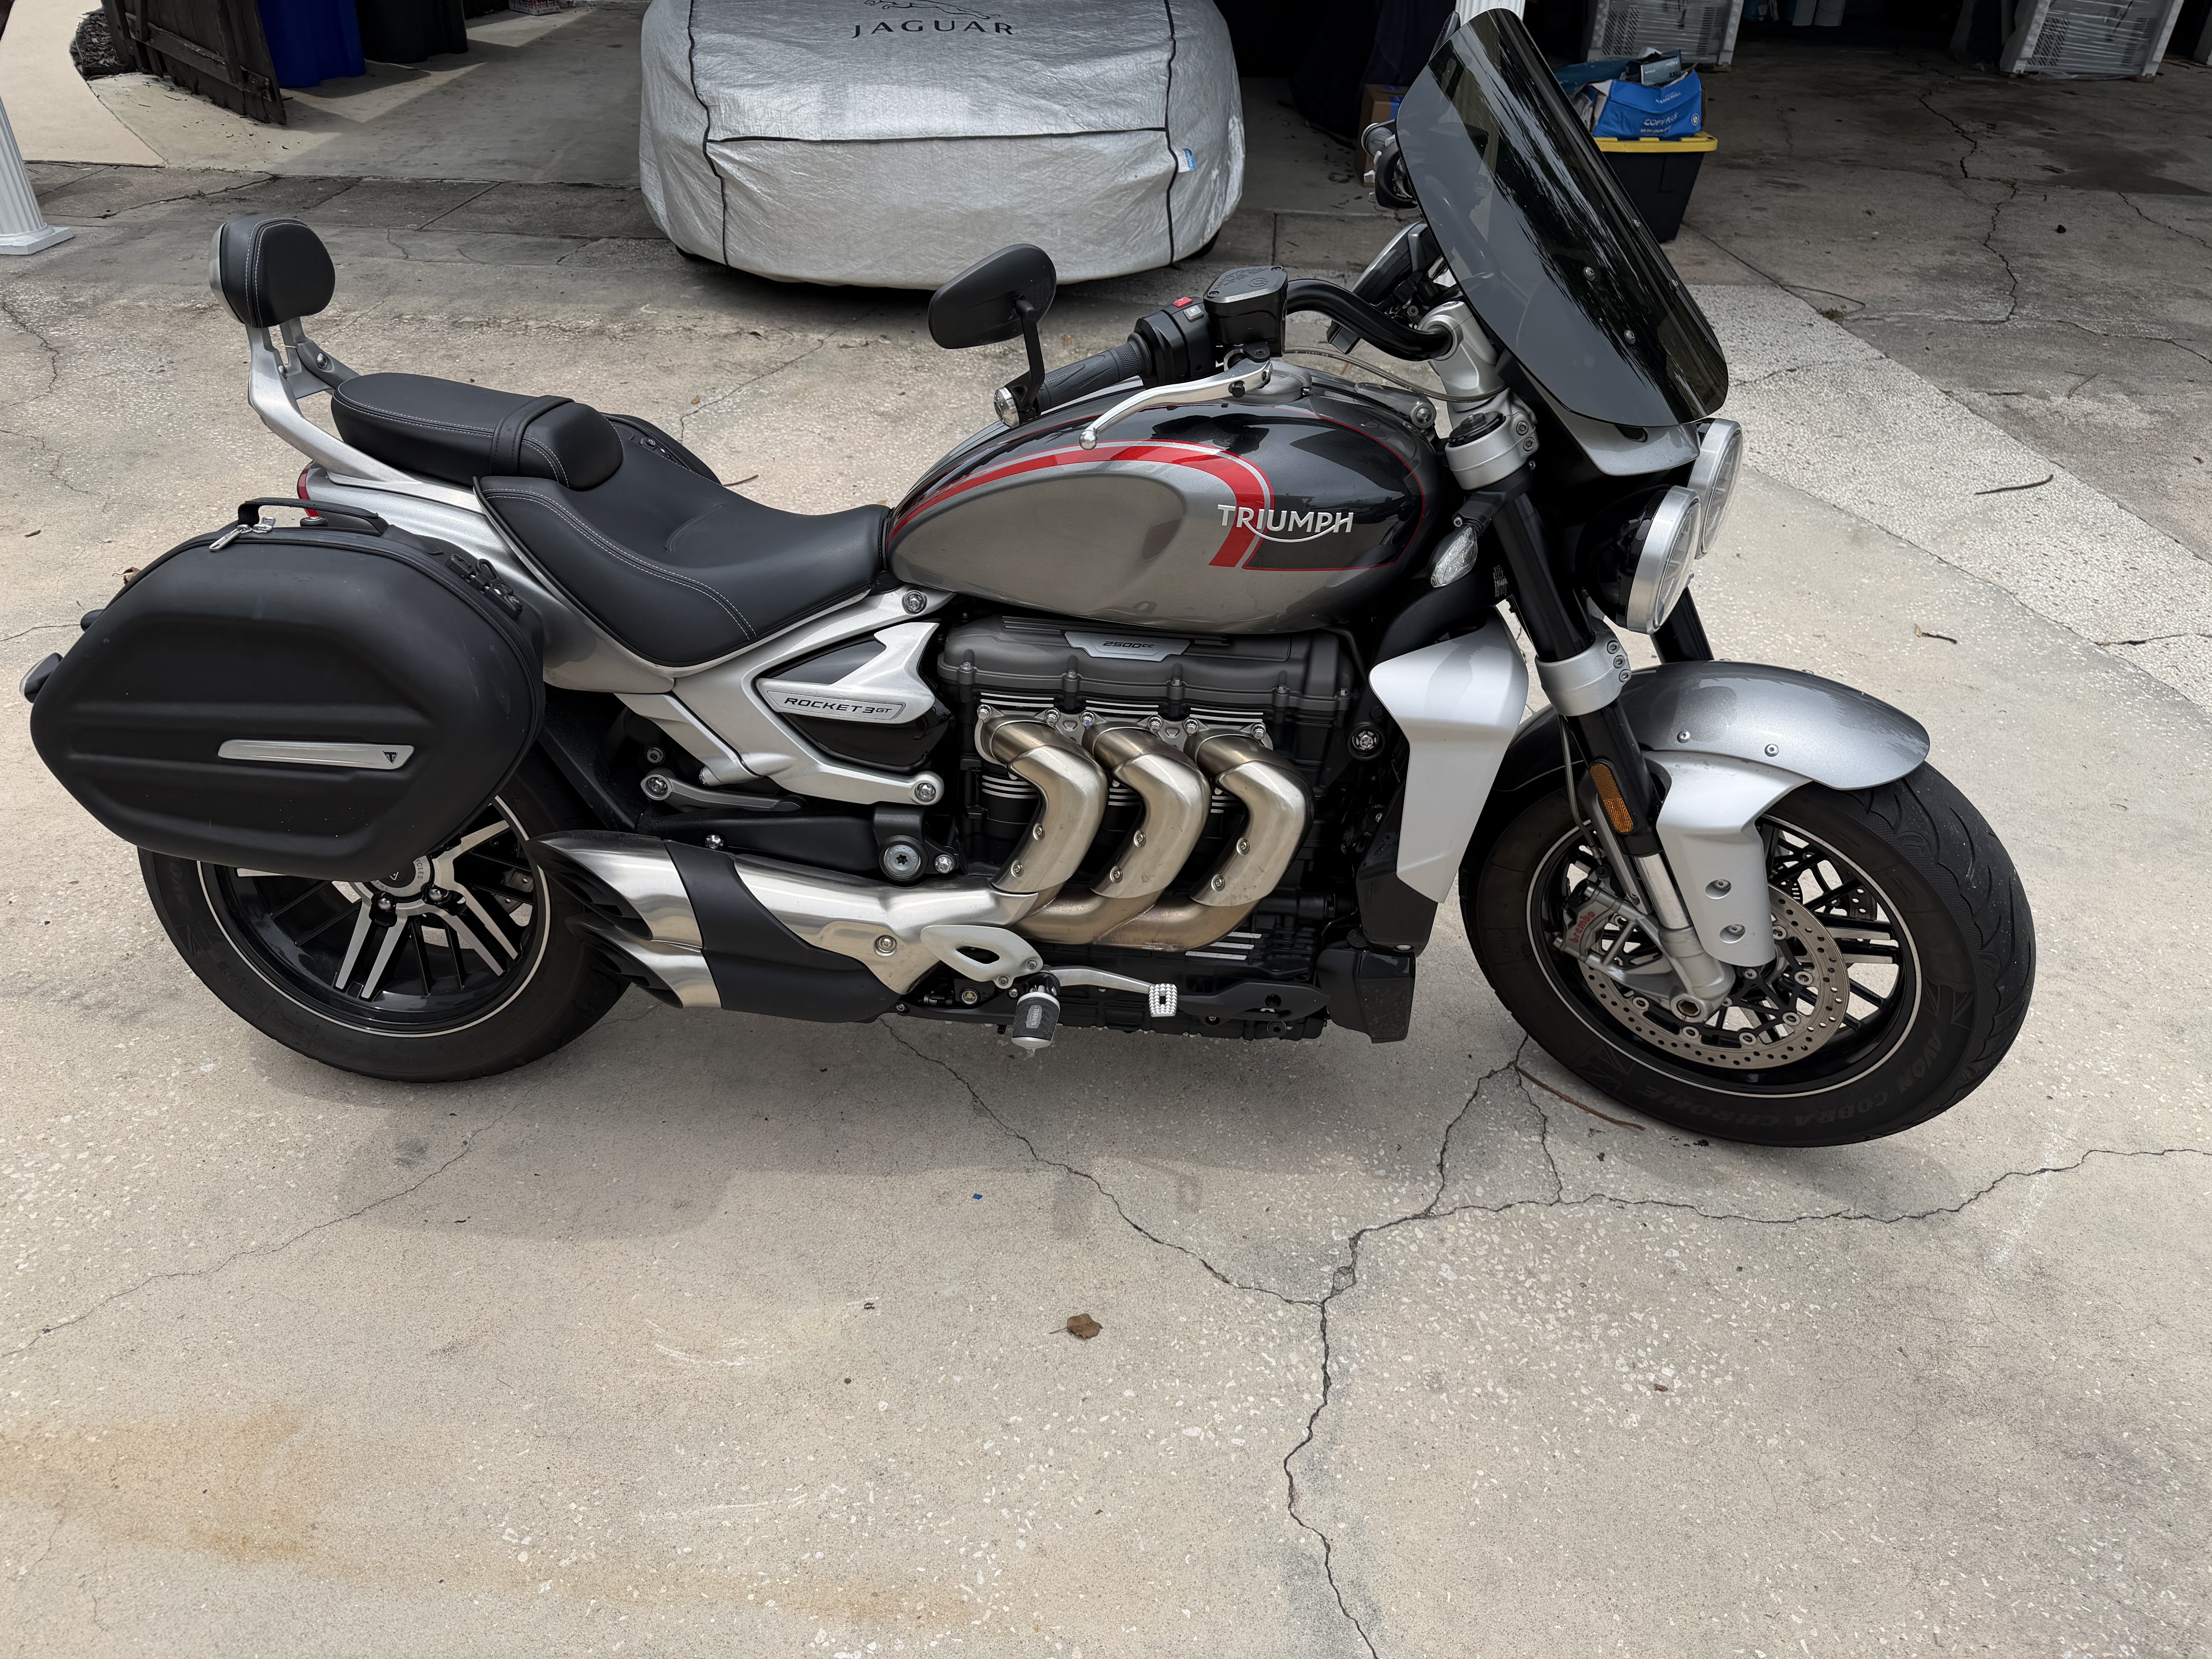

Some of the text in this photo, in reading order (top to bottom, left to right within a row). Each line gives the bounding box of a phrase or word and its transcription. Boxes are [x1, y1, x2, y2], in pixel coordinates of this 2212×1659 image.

[852, 20, 1013, 39] JAGUAR
[1218, 504, 1354, 543] TRIUMPH
[1568, 911, 1595, 943] brembo
[1635, 1028, 1942, 1127] AVON COBRA CHROME
